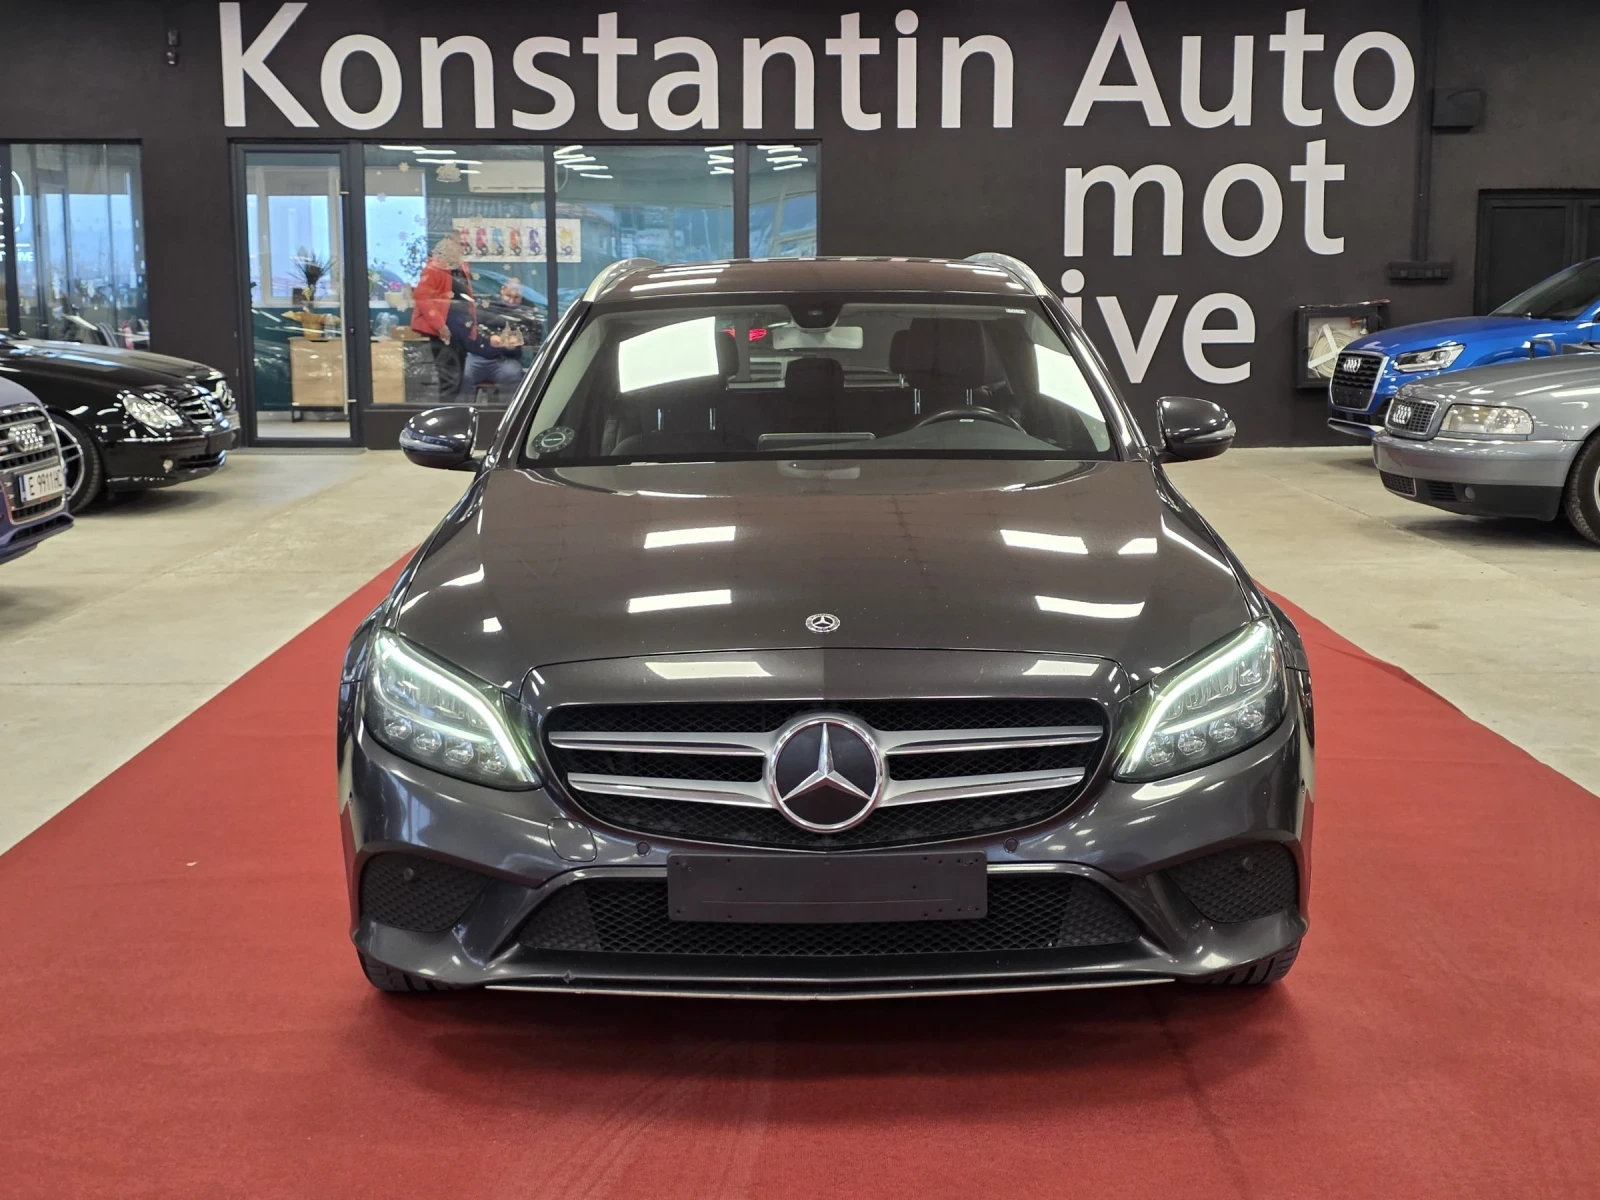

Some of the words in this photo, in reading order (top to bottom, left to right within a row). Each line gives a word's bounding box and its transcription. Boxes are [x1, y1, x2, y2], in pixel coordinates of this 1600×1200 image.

[220, 2, 1015, 131] Konstantin
[1063, 1, 1416, 129] Auto
[1063, 138, 1346, 257] mot
[1060, 268, 1257, 385] ive
